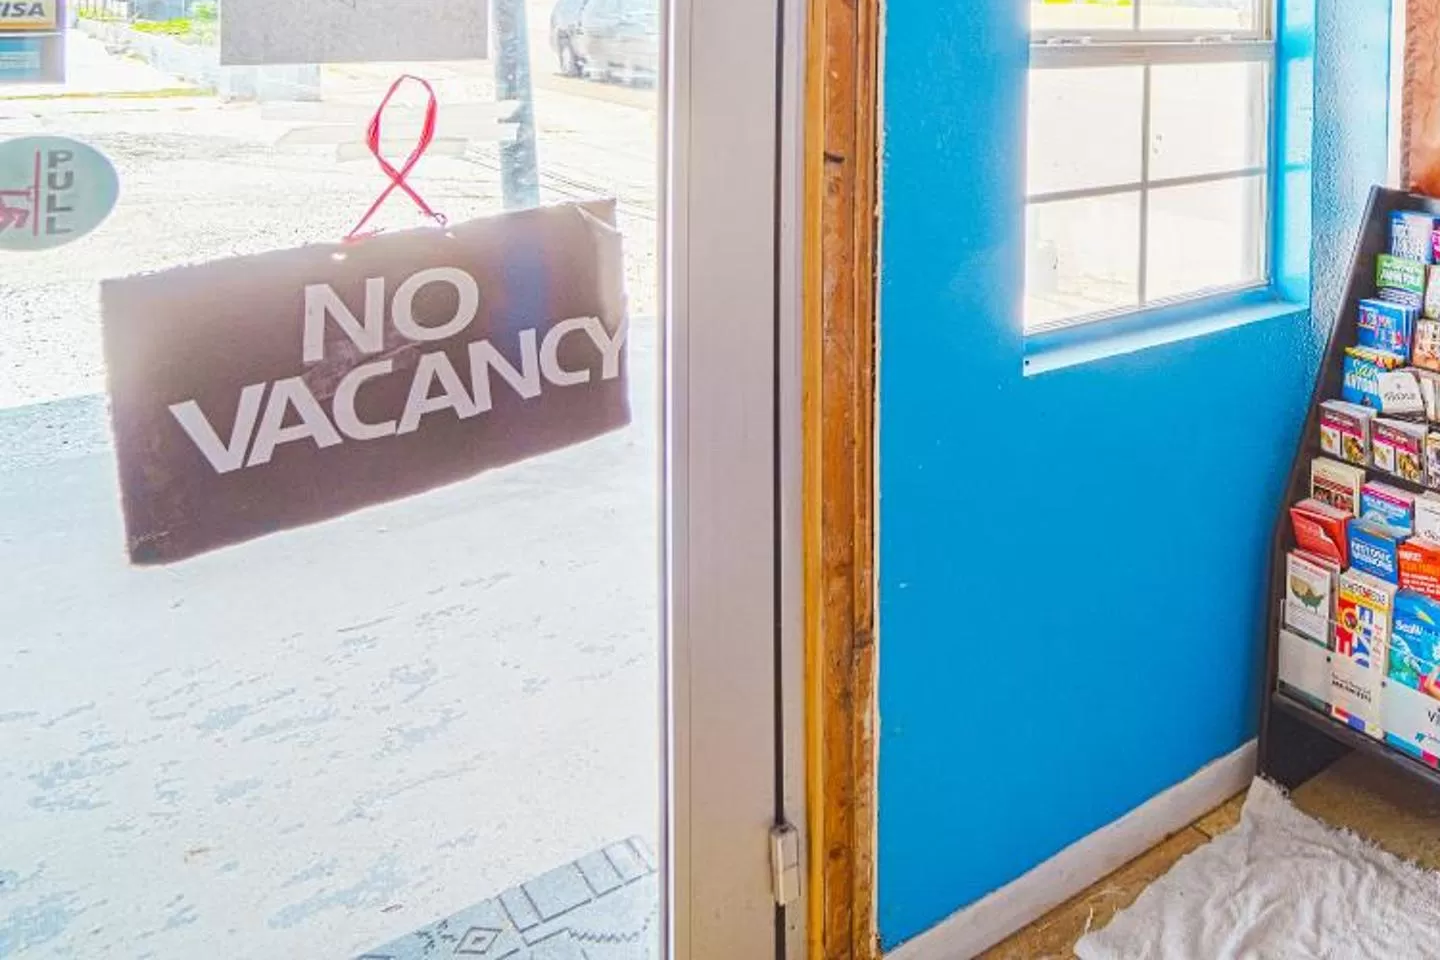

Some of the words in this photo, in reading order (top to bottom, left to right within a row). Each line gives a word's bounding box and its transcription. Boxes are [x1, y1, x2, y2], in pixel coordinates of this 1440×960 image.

[0, 1, 46, 18] ISA
[46, 148, 75, 235] PULL
[302, 266, 480, 363] NO
[168, 315, 628, 475] VACANCY
